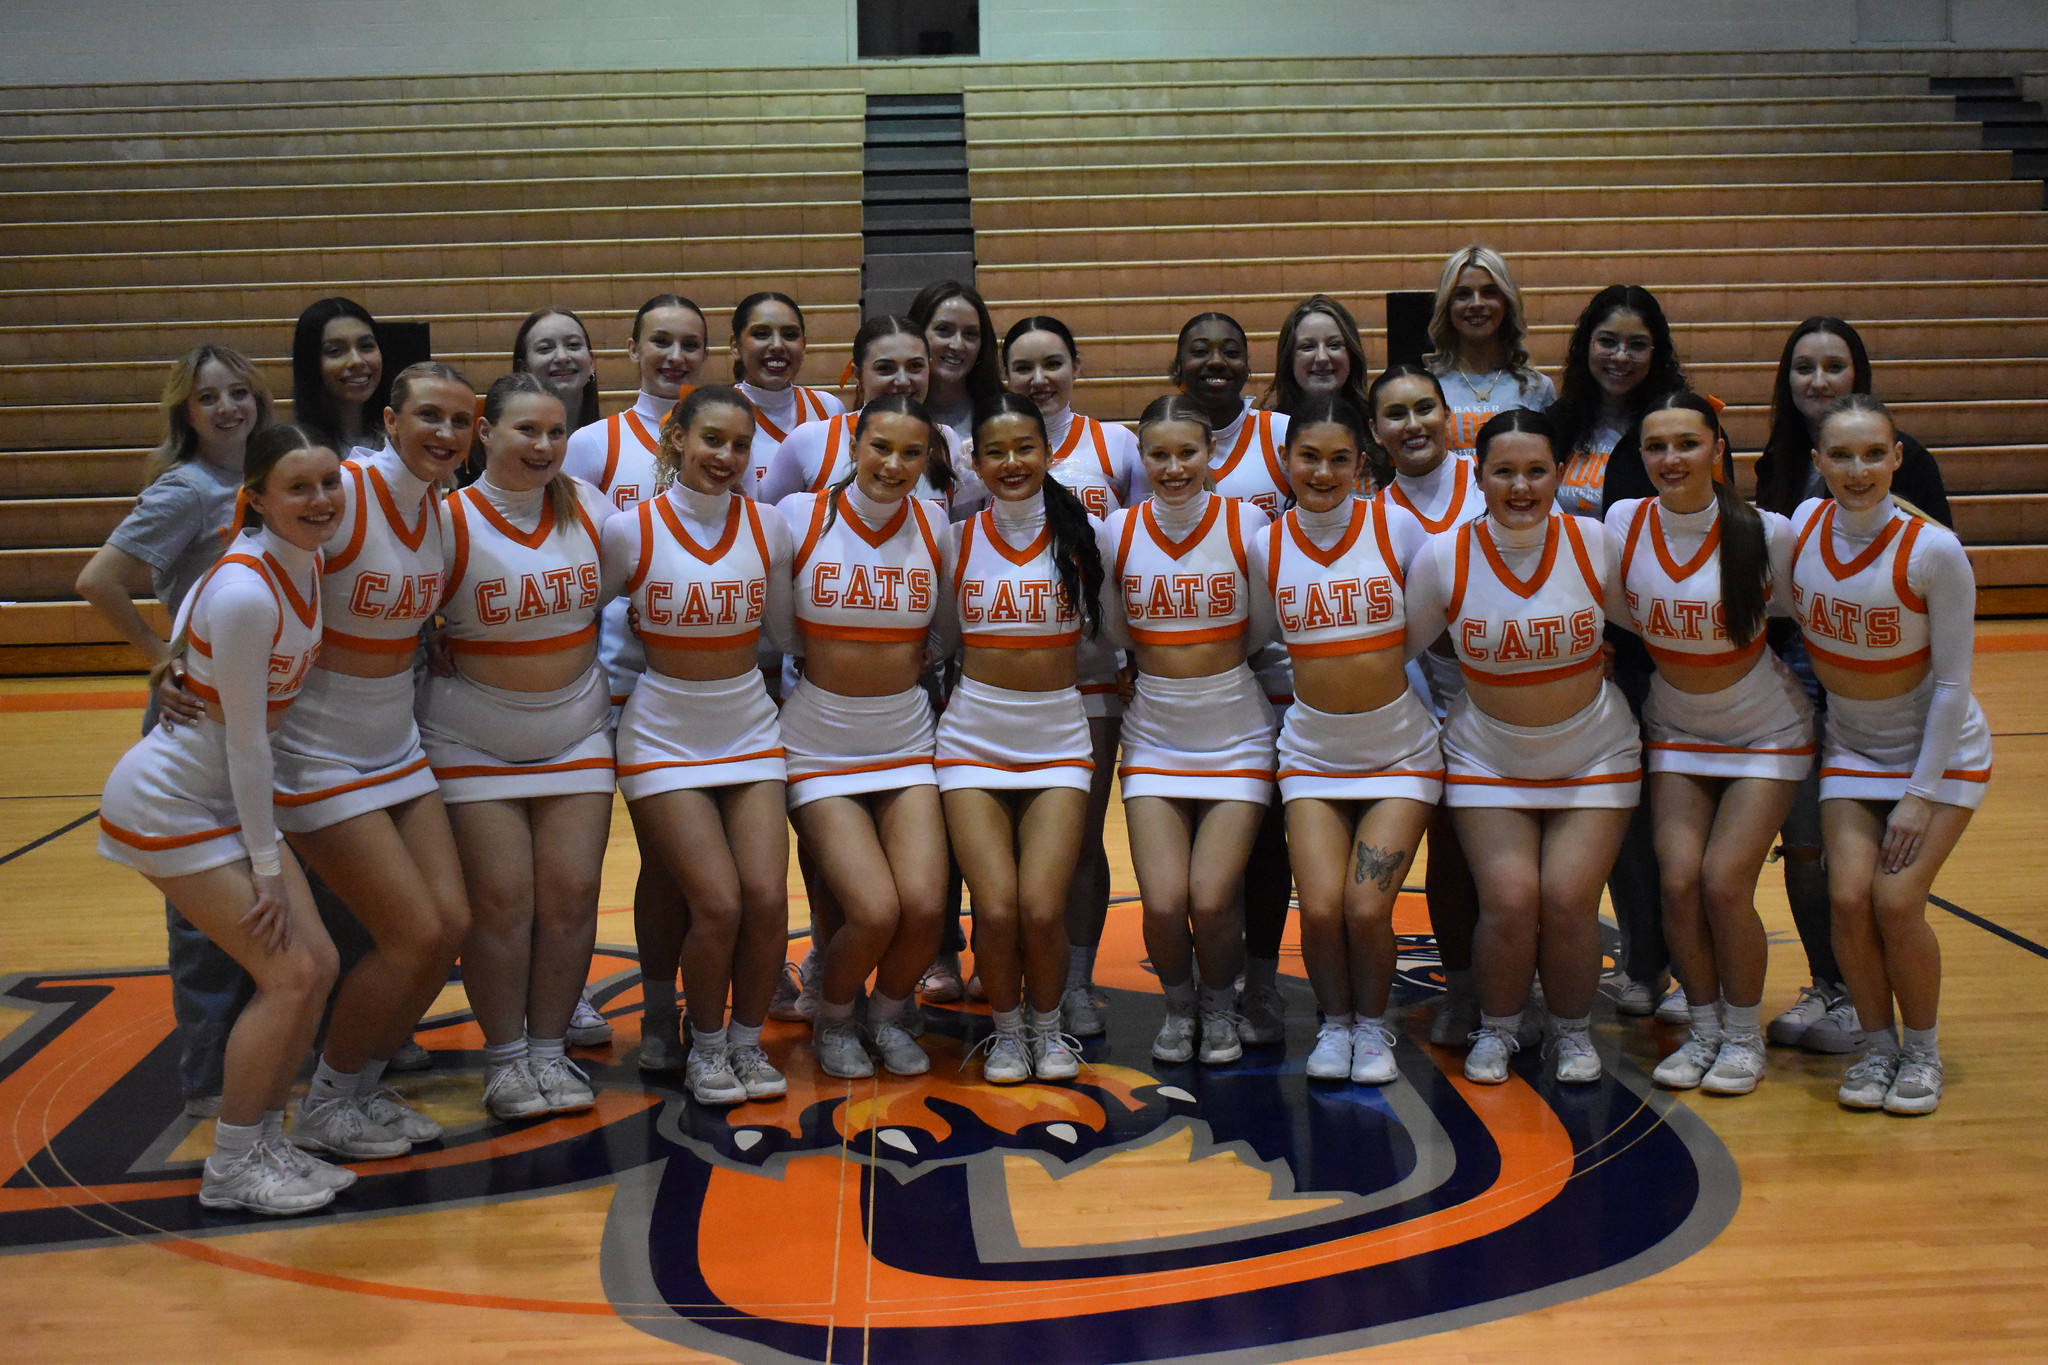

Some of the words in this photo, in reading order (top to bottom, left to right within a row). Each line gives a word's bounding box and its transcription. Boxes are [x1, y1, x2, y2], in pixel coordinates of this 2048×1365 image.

[1453, 404, 1500, 413] BAKER
[474, 562, 599, 626] CATS
[646, 580, 767, 627] CATS
[812, 562, 932, 612] CATS
[1124, 572, 1236, 619] CATS
[1277, 576, 1394, 632] CATS
[1461, 606, 1597, 662] CATS
